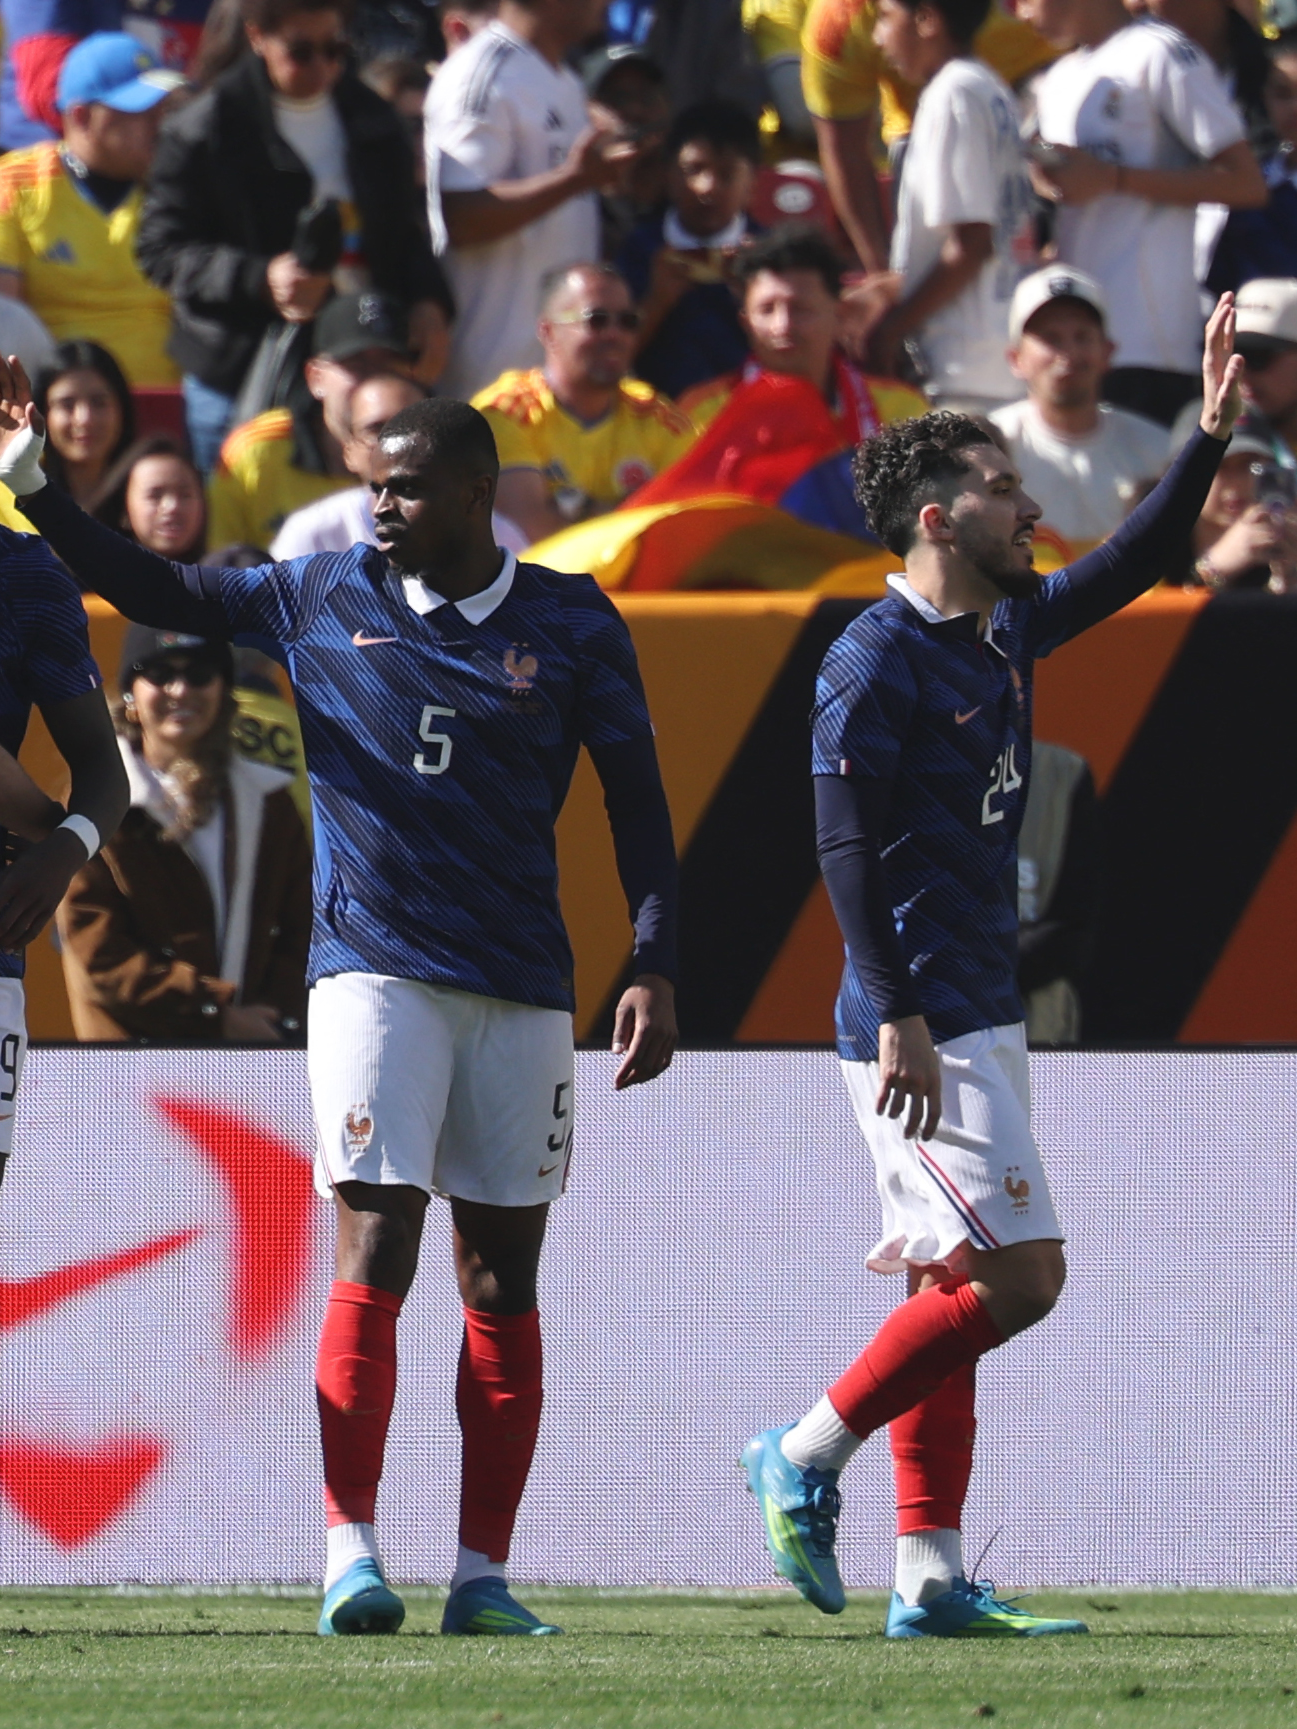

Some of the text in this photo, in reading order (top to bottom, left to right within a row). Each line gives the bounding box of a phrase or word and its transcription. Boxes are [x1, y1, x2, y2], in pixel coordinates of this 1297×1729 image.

[413, 705, 456, 774] 5
[981, 743, 1022, 825] 24
[0, 1033, 19, 1101] 9
[547, 1081, 570, 1152] 5
